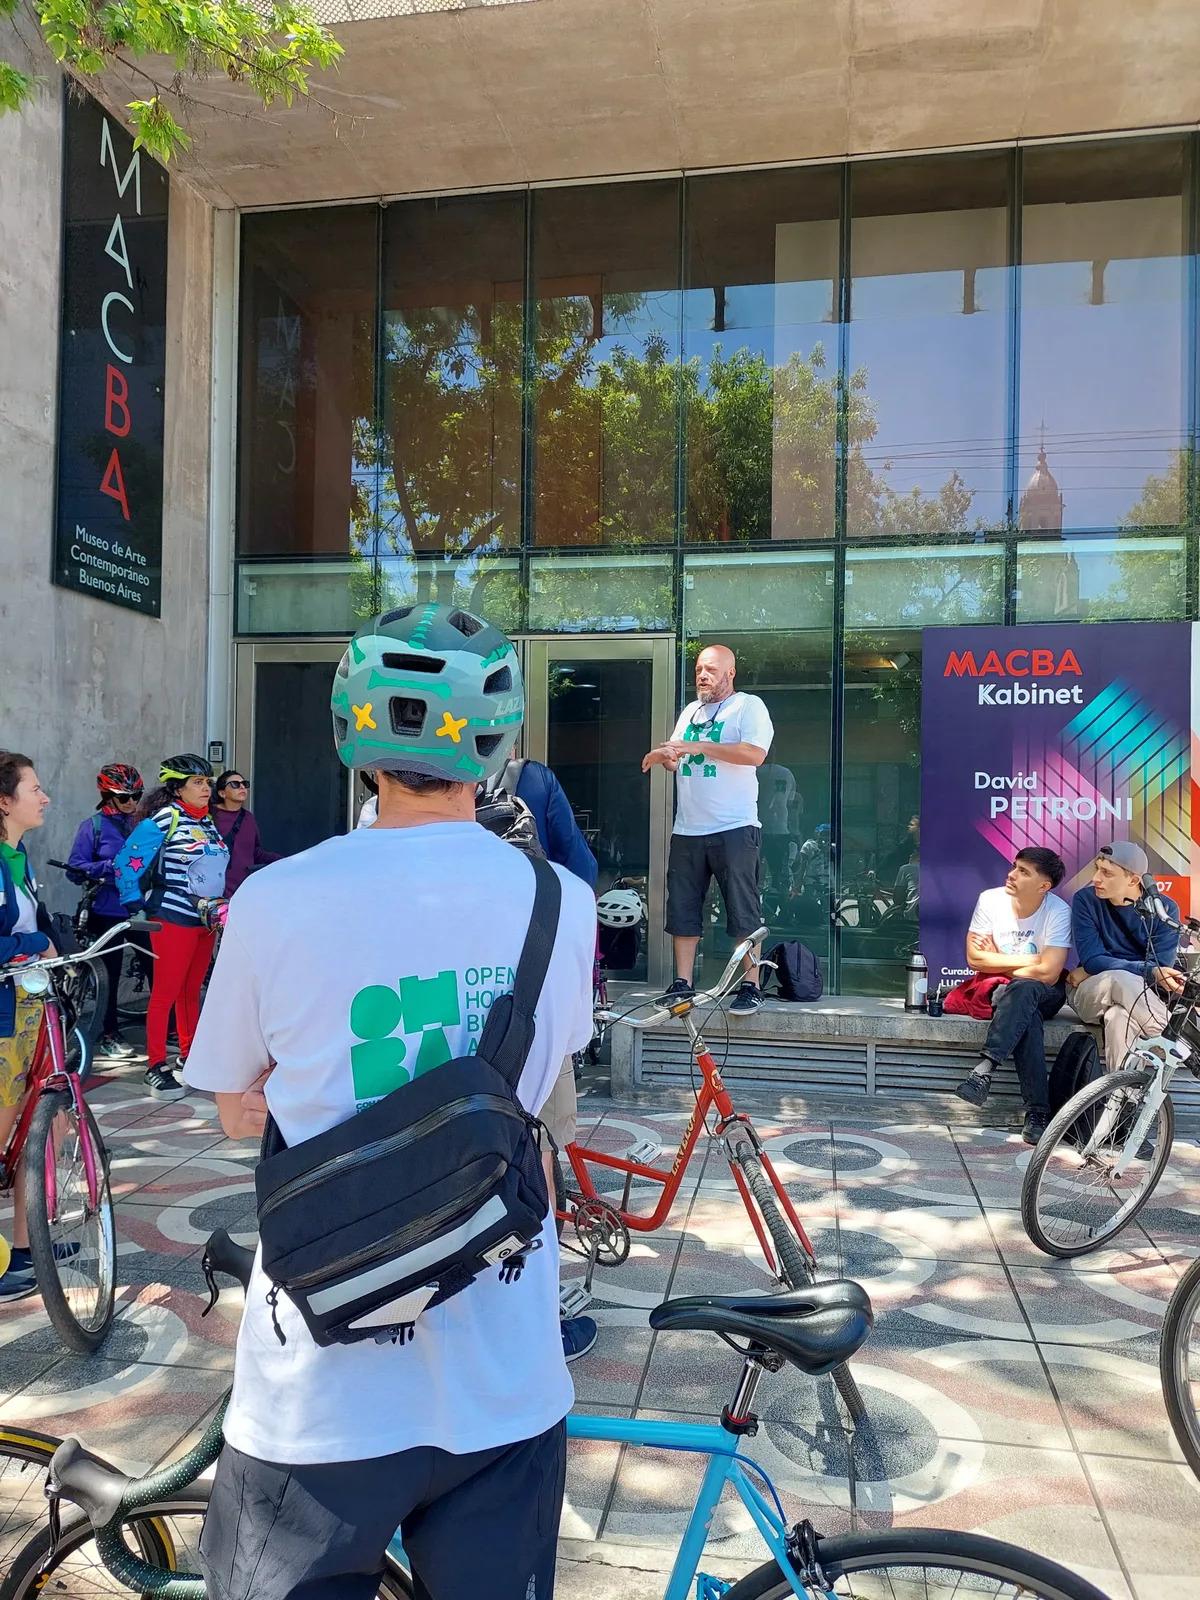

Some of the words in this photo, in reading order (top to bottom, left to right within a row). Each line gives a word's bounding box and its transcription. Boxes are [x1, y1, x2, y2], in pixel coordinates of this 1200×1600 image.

[100, 116, 141, 520] MACBA
[75, 524, 109, 551] Museo
[111, 541, 124, 557] de
[124, 546, 147, 566] Arte
[70, 544, 150, 586] Contemporáneo
[79, 568, 116, 594] Buenos
[116, 582, 142, 603] Aires
[943, 649, 1083, 677] MACBA
[978, 682, 1083, 705] Kabinet
[974, 771, 1037, 790] David
[990, 796, 1133, 821] PETRONI
